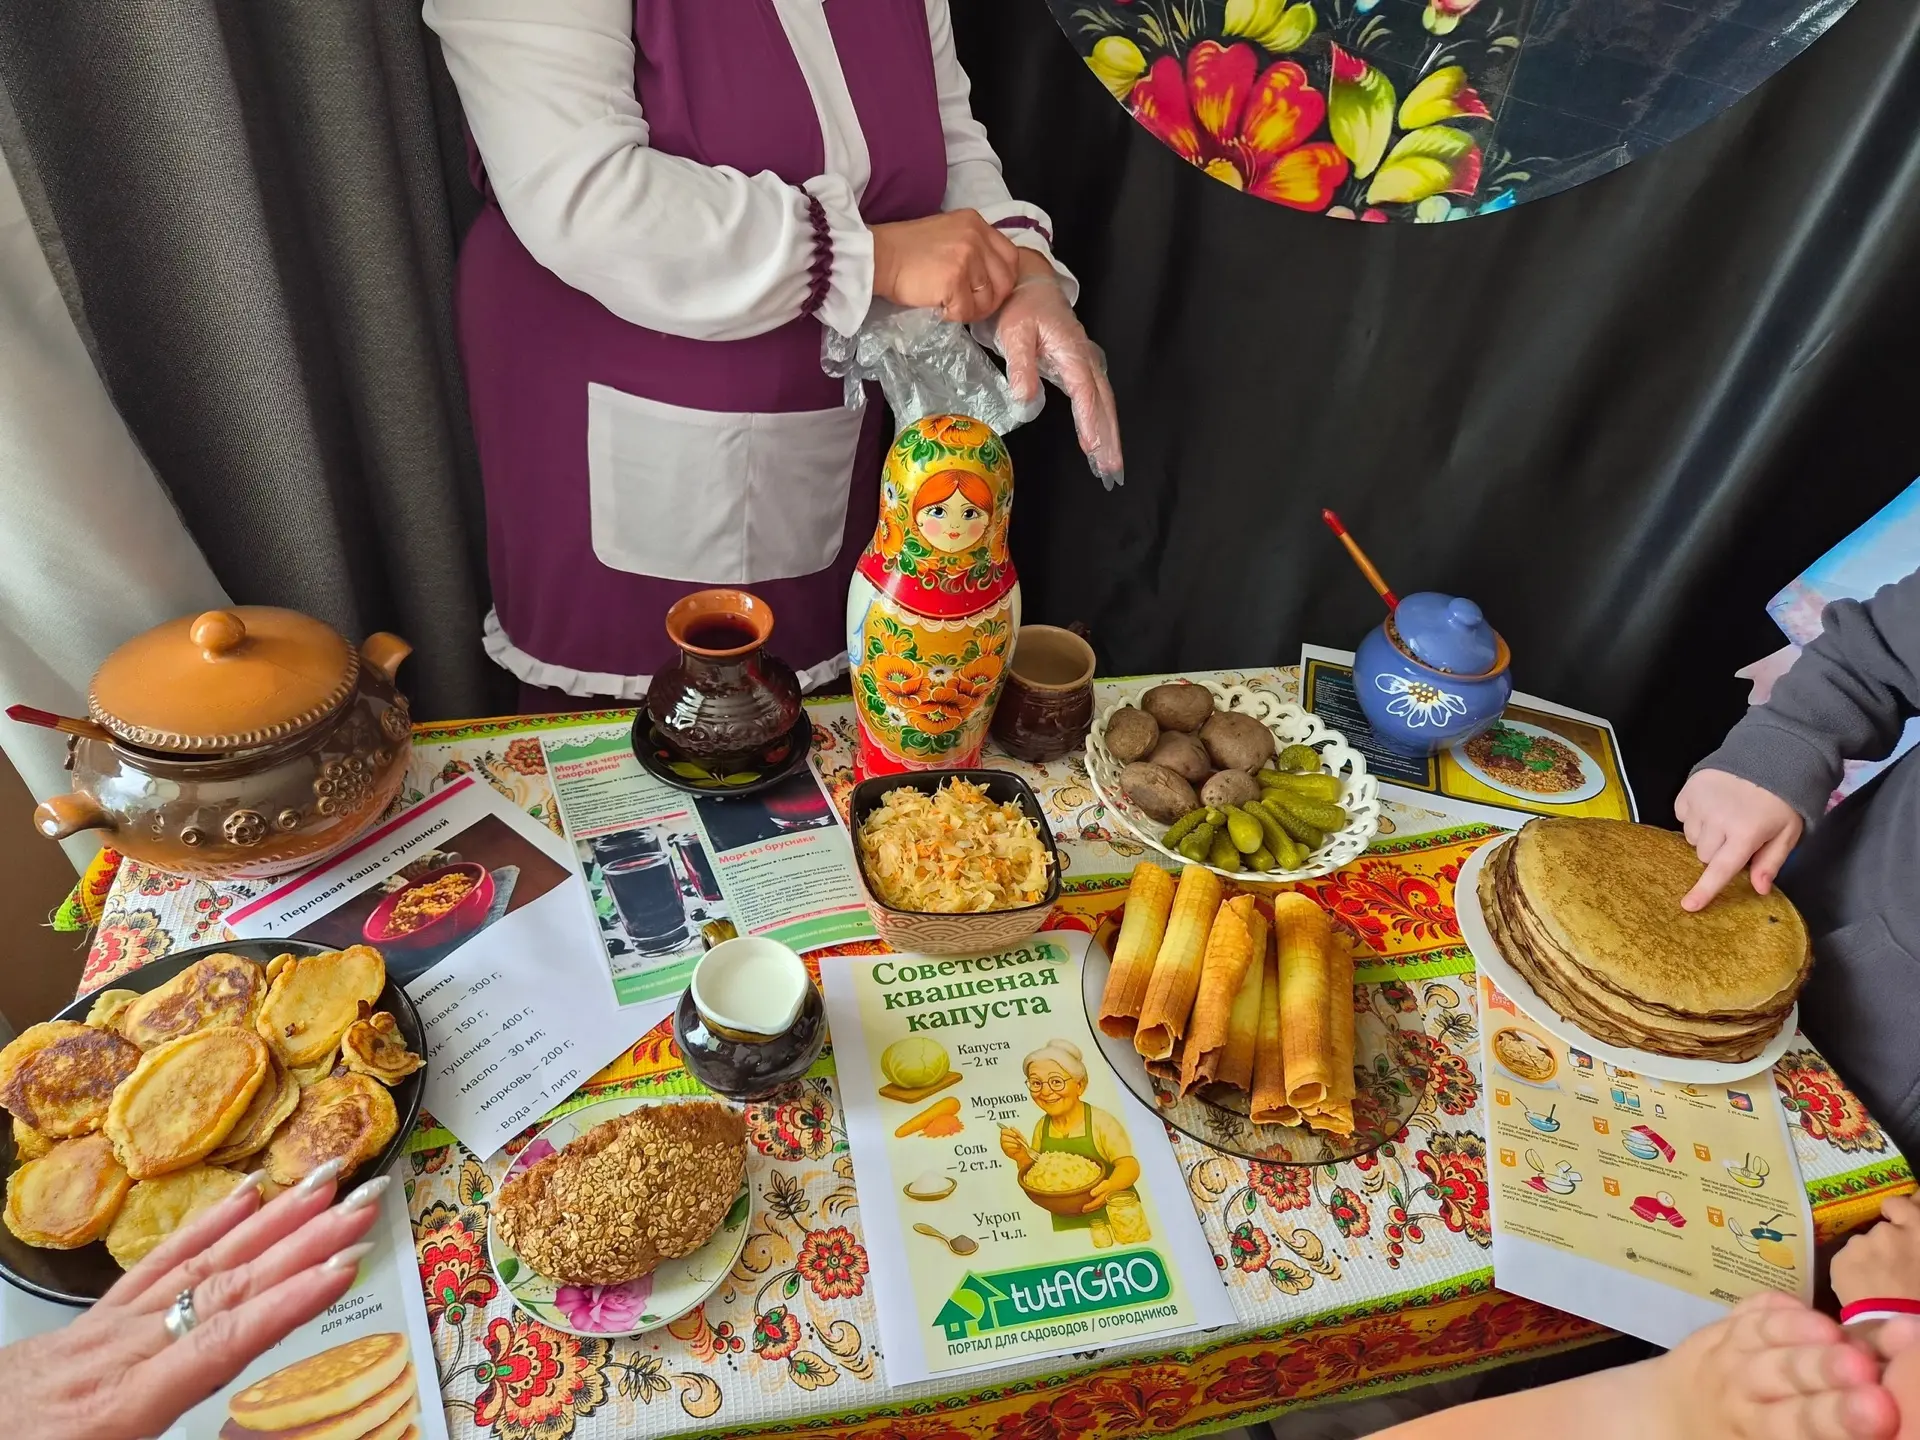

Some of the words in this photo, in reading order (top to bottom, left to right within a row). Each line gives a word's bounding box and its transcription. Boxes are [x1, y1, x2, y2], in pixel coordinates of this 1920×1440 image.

[554, 763, 585, 773] Морс
[600, 752, 635, 763] черно
[556, 763, 621, 780] смородины
[718, 852, 748, 865] Морс
[750, 847, 763, 857] из
[764, 835, 817, 853] брусники
[263, 921, 280, 931] 7.
[282, 881, 346, 923] Перловая
[347, 860, 381, 885] каша
[382, 853, 391, 862] с
[390, 818, 450, 857] тушенкой
[872, 943, 1056, 986] Советская
[412, 973, 456, 1007] диенты
[424, 1002, 459, 1031] ловка
[468, 978, 491, 995] 300
[882, 968, 1060, 1010] квашеная
[906, 995, 1052, 1033] капуста
[428, 1042, 445, 1058] ук
[454, 1017, 477, 1034] 150
[440, 1038, 491, 1077] тушенка
[501, 1013, 524, 1032] 400
[957, 1041, 1011, 1055] Капуста
[461, 1062, 499, 1094] масло
[507, 1044, 525, 1058] 30
[480, 1072, 532, 1112] морковь
[540, 1046, 564, 1066] 200
[985, 1057, 999, 1066] кг
[500, 1106, 531, 1130] вода
[540, 1090, 549, 1100] 1
[550, 1070, 581, 1094] литр.
[970, 1093, 1028, 1108] Морковь
[998, 1110, 1020, 1120] шт.
[954, 1144, 988, 1156] Соль
[973, 1211, 1021, 1227] Укроп
[1010, 1257, 1159, 1313] tutAGRO
[320, 1316, 343, 1335] для
[345, 1301, 383, 1326] жарки
[326, 1296, 365, 1317] Масло
[947, 1337, 993, 1356] ПОРТАЛ
[994, 1334, 1018, 1349] ДЛЯ
[1020, 1318, 1089, 1343] САДОВОДОВ
[1090, 1317, 1096, 1332] /
[1098, 1304, 1179, 1328] ОГОРОДНИКОВ
